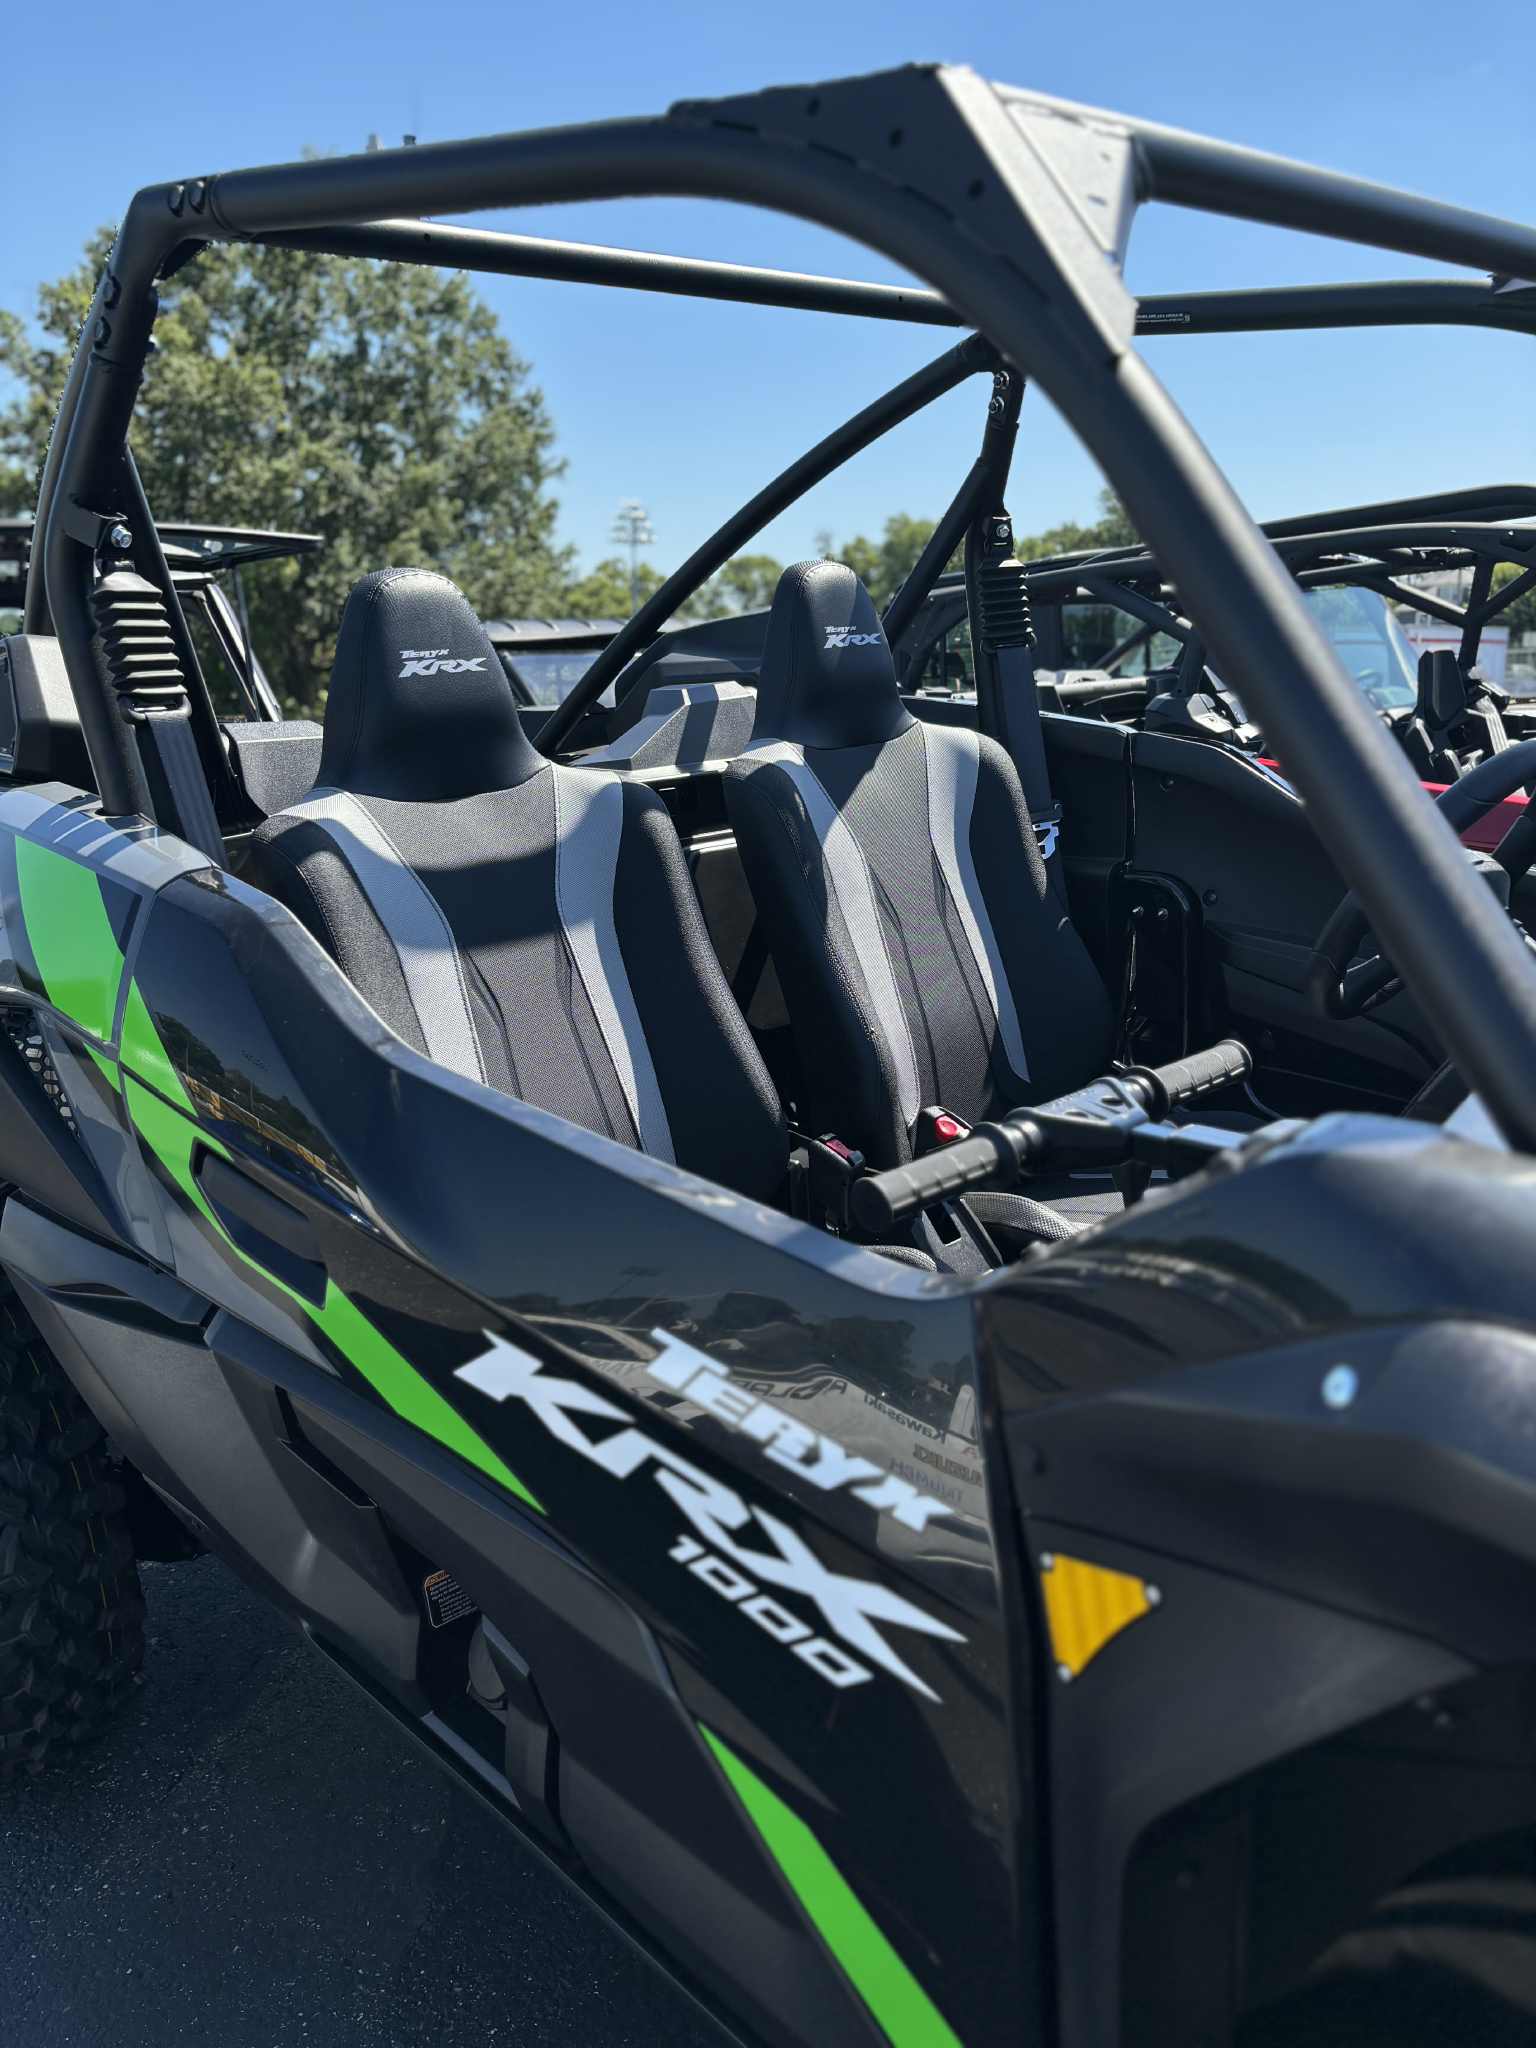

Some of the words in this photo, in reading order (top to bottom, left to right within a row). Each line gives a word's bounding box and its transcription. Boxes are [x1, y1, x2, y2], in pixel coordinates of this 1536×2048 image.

[399, 657, 488, 678] KRX
[823, 633, 881, 649] KRX
[646, 1327, 954, 1533] TERYX
[452, 1328, 968, 1704] KRX
[668, 1534, 874, 1688] 1000
